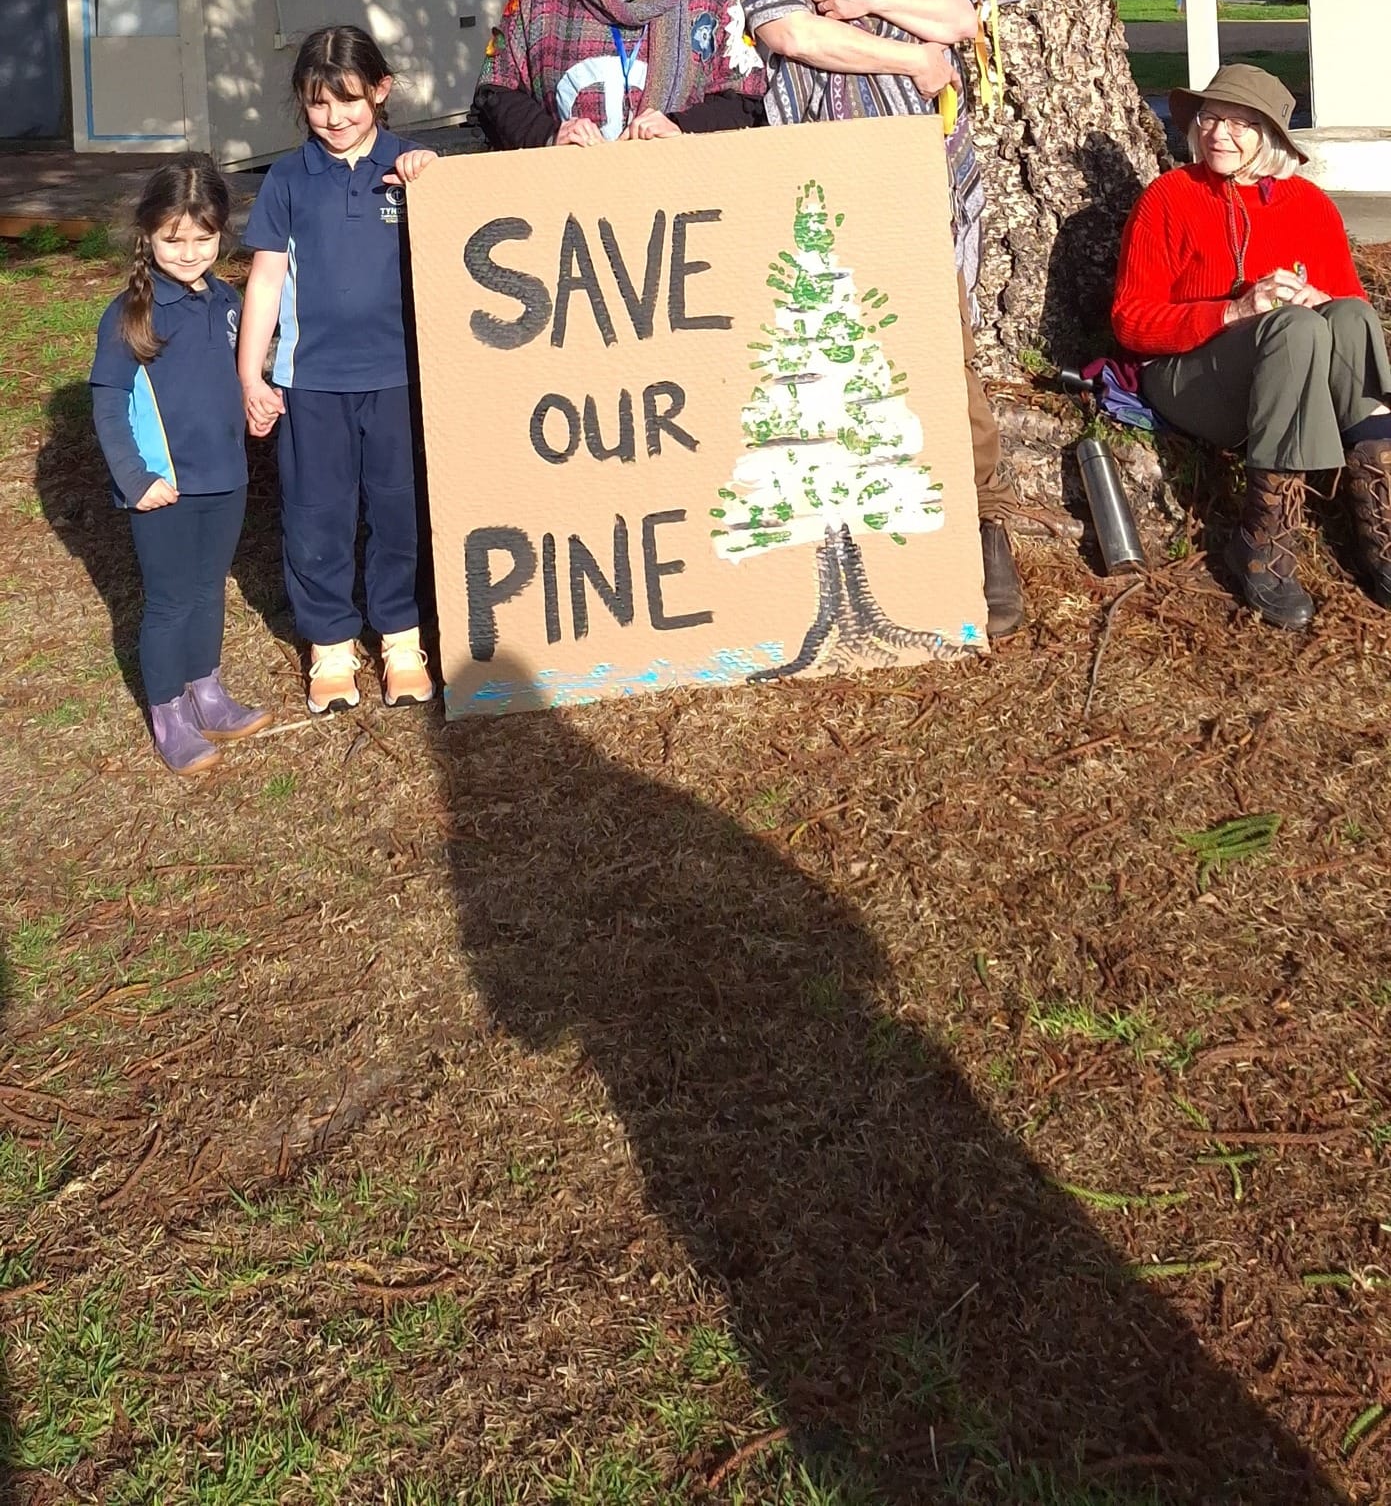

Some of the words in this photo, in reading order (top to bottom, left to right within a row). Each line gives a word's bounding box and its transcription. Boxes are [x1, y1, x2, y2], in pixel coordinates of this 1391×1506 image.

[463, 209, 735, 351] SAVE
[529, 381, 700, 464] OUR
[464, 508, 714, 662] PINE
